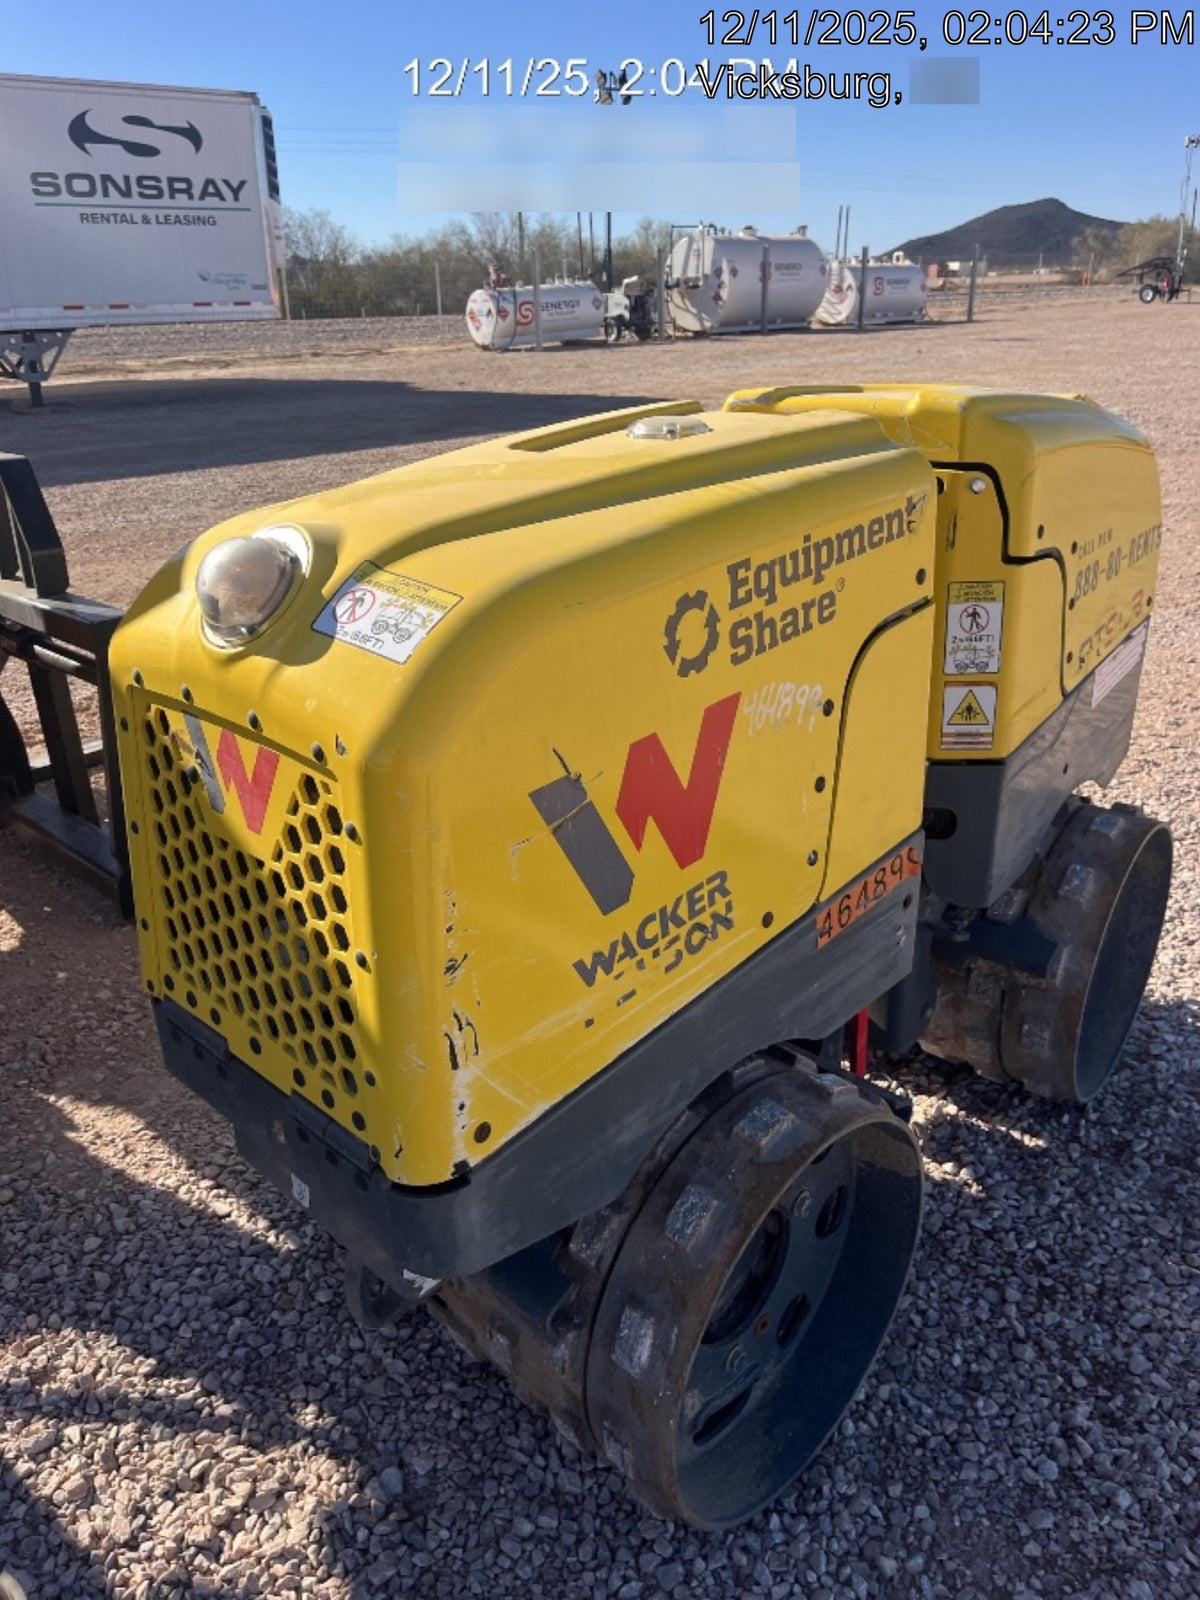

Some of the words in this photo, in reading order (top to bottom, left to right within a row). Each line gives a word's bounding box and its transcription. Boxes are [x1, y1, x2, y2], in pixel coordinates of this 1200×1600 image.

[29, 170, 248, 203] SONSRAY
[79, 211, 139, 226] RENTAL
[141, 213, 152, 226] &
[155, 213, 218, 228] LEASING
[726, 494, 918, 612] Equipment
[572, 870, 732, 988] WACKER
